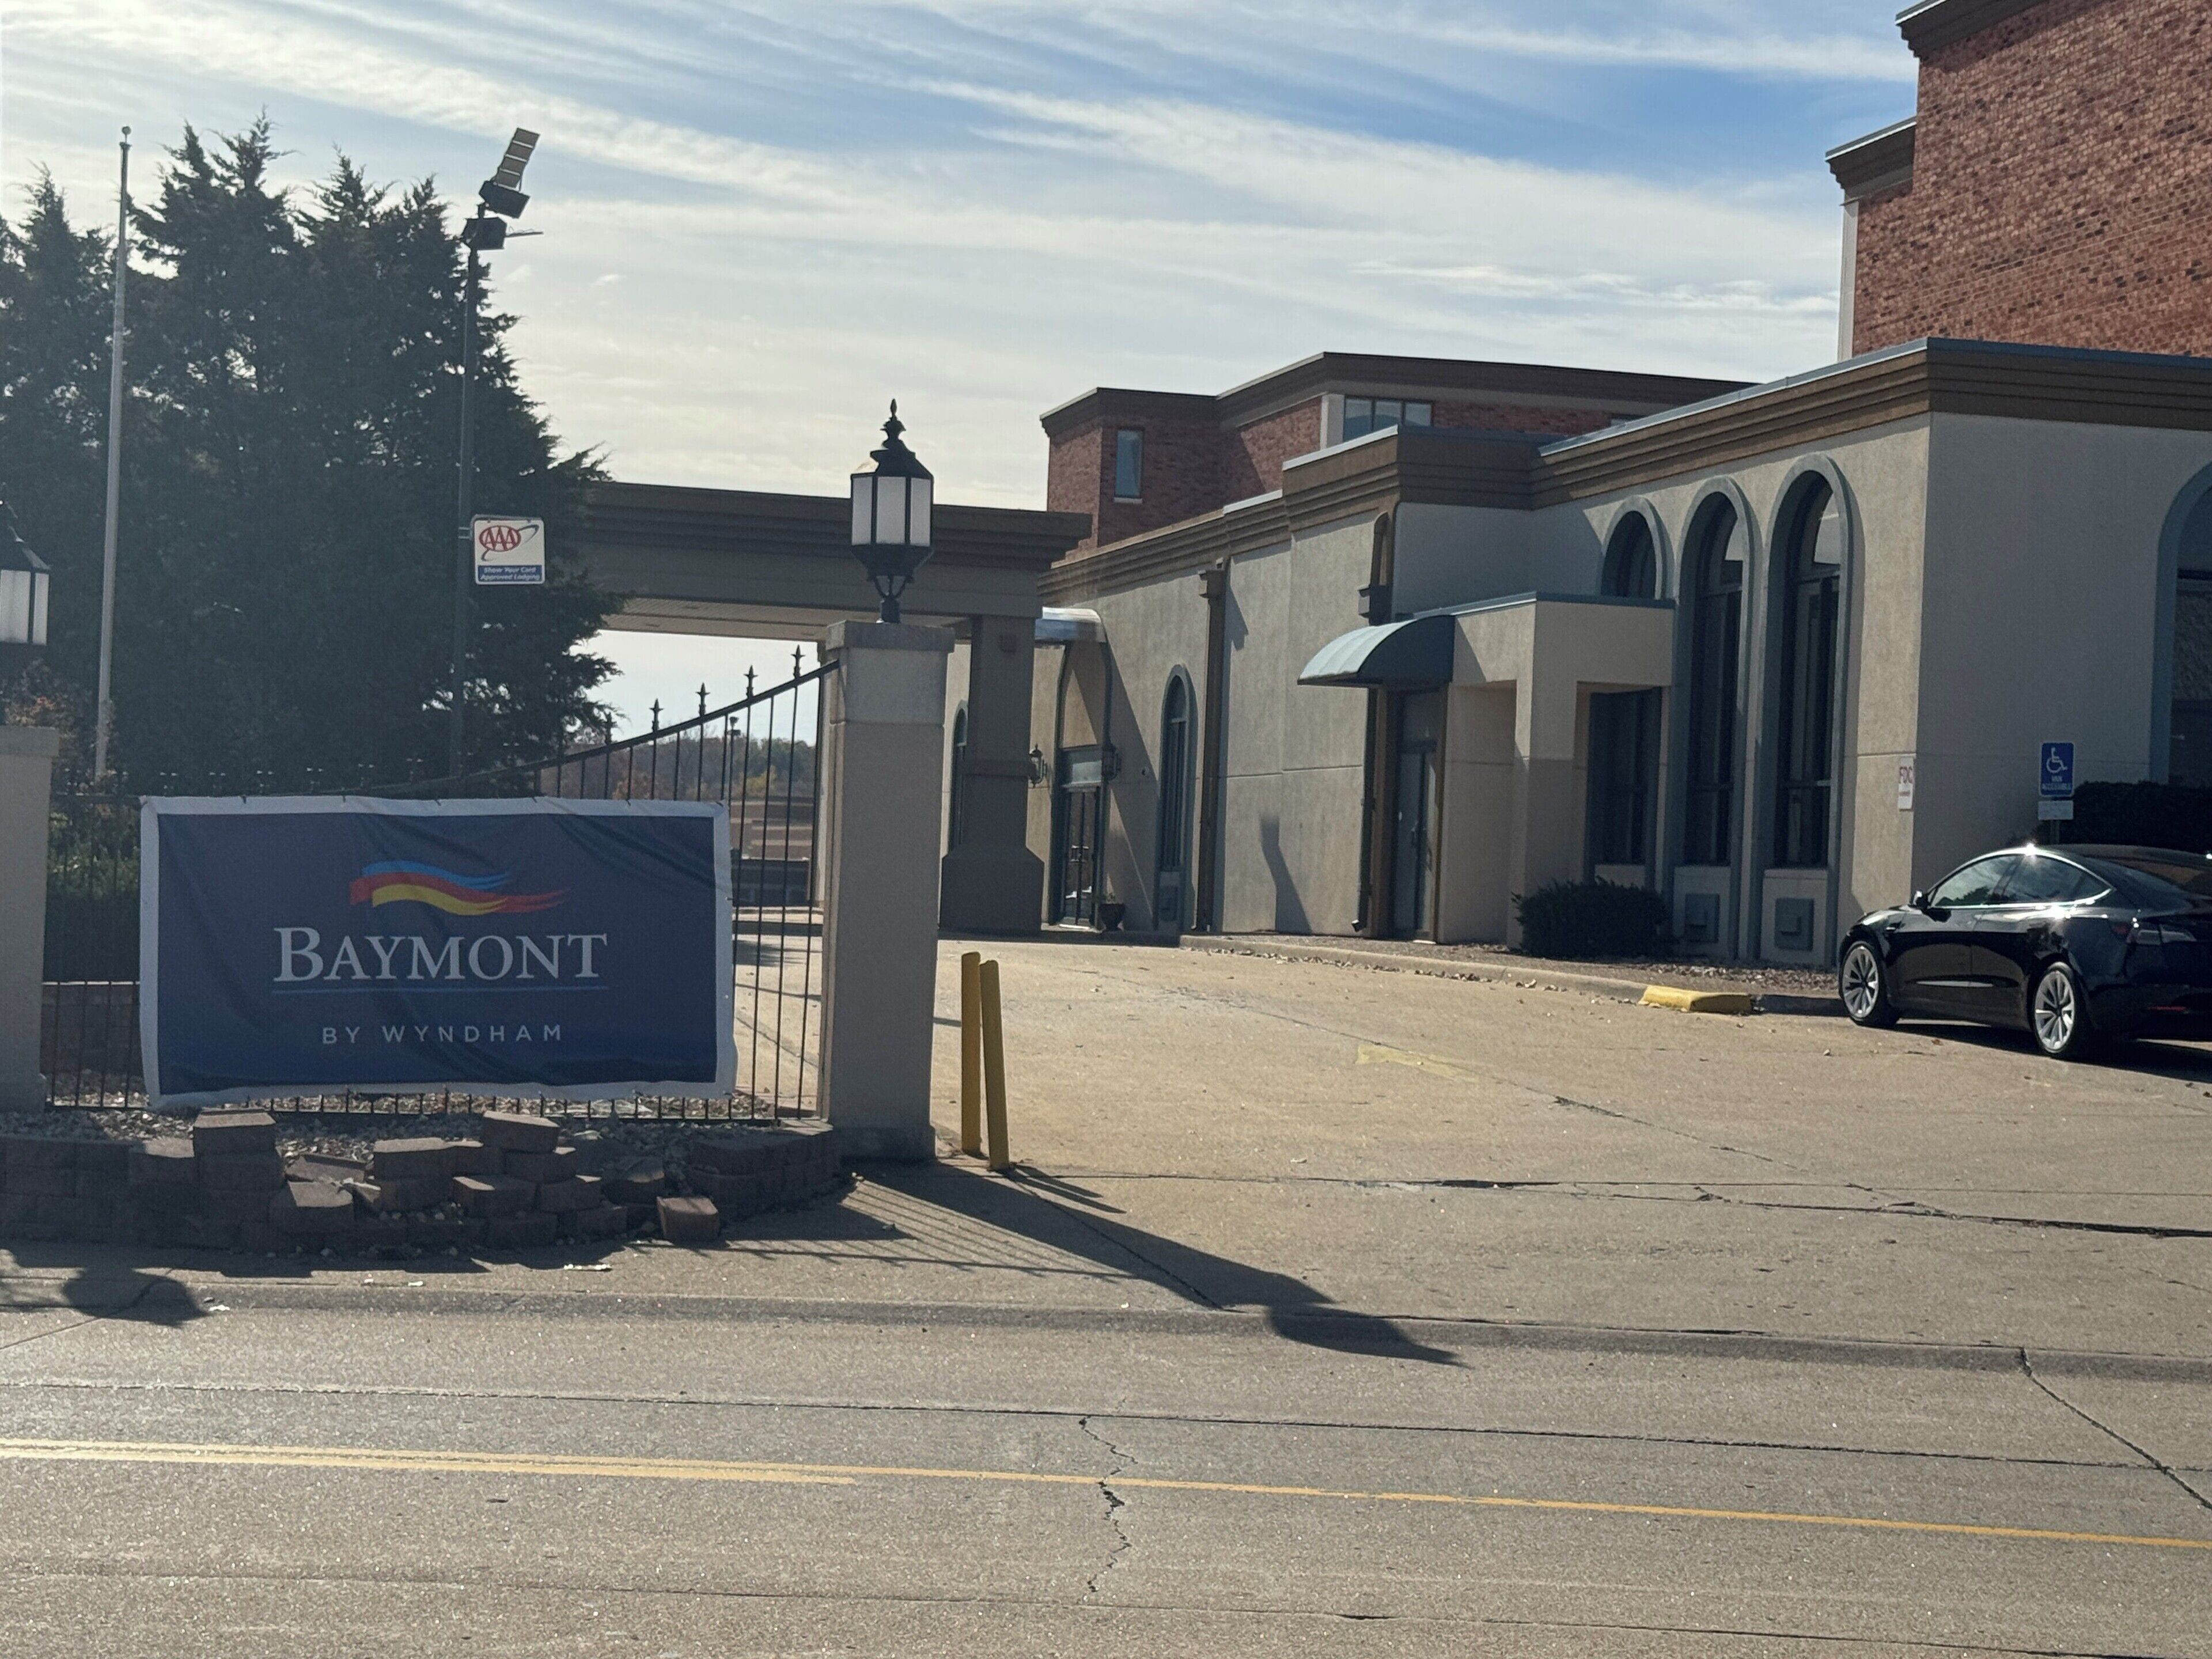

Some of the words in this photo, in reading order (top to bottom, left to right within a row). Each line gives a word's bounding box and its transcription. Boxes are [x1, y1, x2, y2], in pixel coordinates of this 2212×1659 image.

[482, 525, 518, 551] AAA
[322, 1027, 361, 1044] BY
[382, 1024, 562, 1043] WYNDHAM
